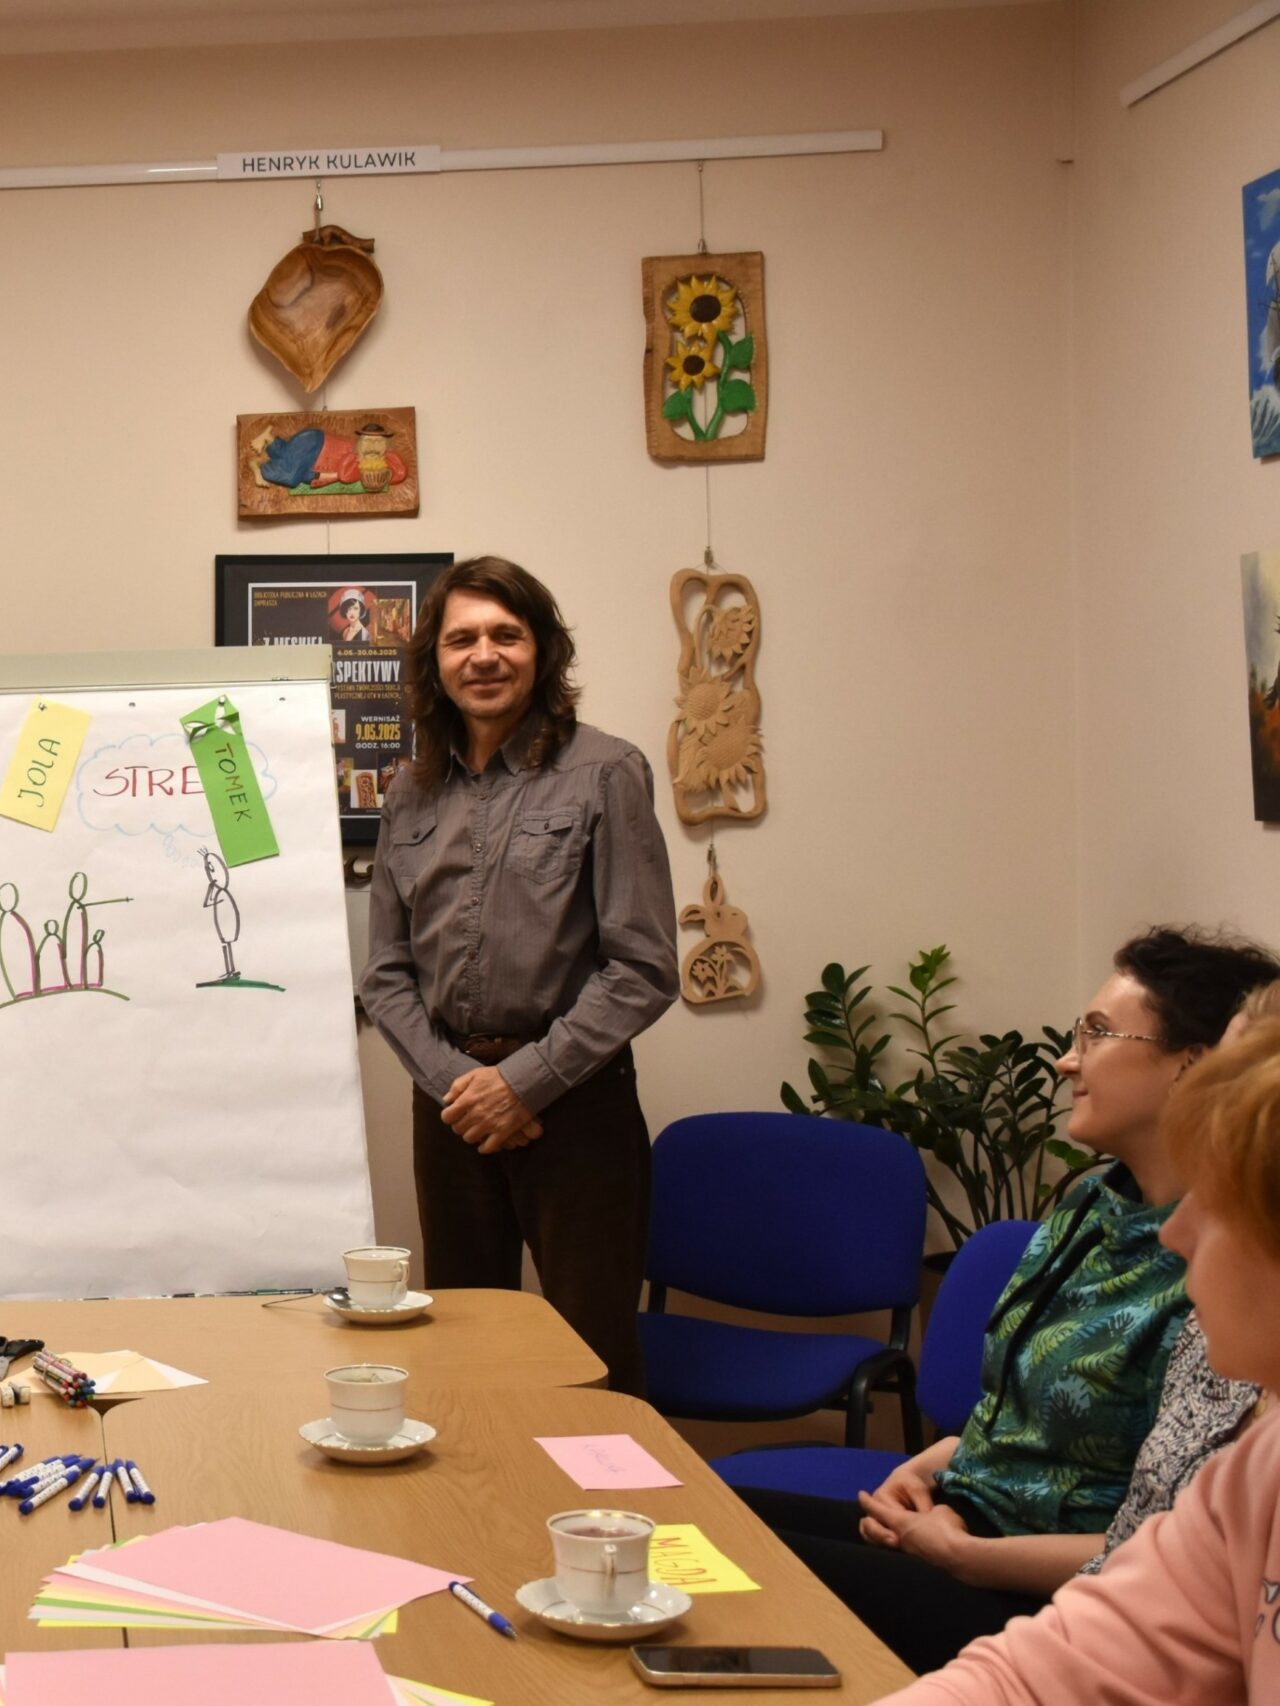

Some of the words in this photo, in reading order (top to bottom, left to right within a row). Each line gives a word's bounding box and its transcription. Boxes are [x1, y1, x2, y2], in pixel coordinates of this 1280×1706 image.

[242, 156, 320, 172] HENRYK
[326, 152, 416, 169] KULAWIK
[333, 660, 401, 683] SPEKTYWY
[355, 723, 401, 741] 9.05.2025
[17, 738, 61, 808] JOLA
[93, 765, 205, 798] STRE
[215, 742, 253, 823] TOMEK
[648, 1536, 718, 1586] MAGDA
